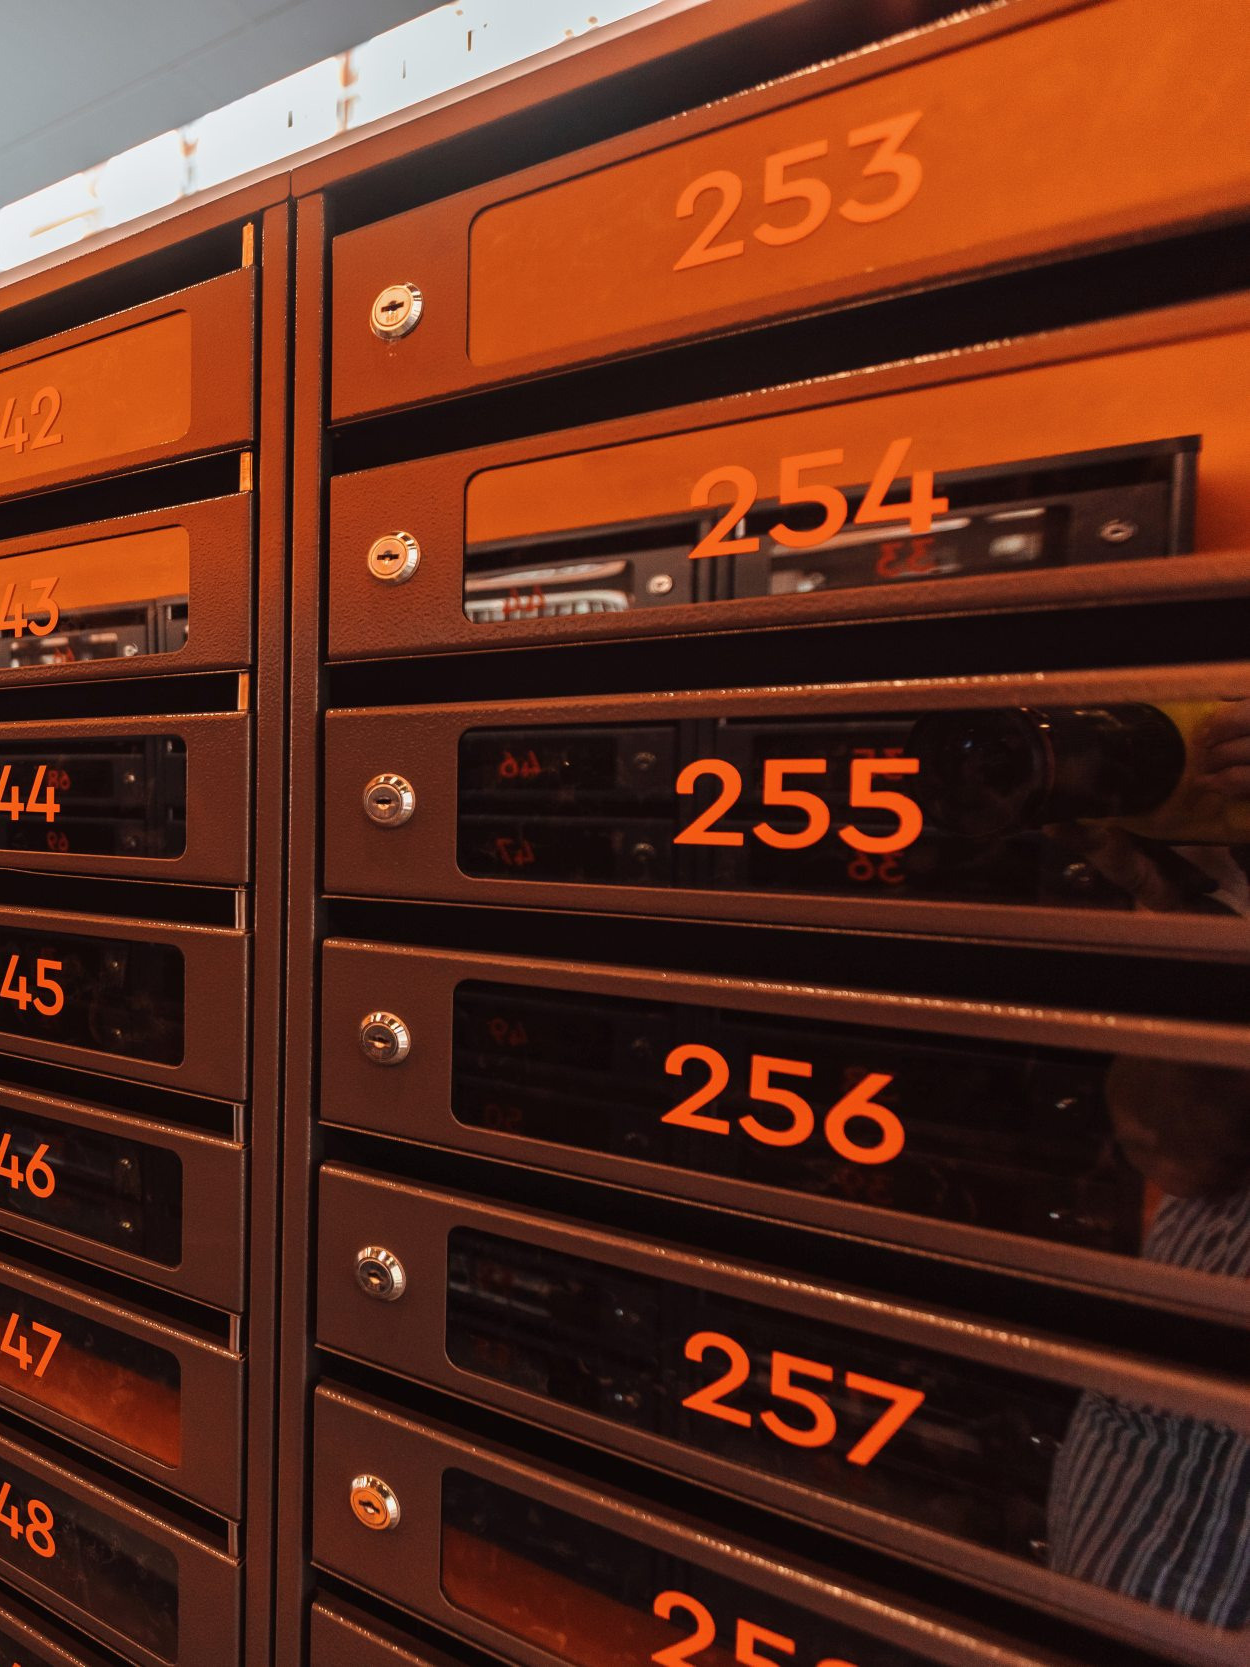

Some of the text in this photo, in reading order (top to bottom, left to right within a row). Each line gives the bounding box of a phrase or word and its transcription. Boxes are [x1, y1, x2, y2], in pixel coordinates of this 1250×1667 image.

[673, 109, 924, 271] 253
[687, 437, 948, 561] 254
[673, 757, 923, 853] 255
[660, 1043, 905, 1165] 256
[681, 1331, 925, 1466] 257
[651, 1590, 860, 1667] 25
